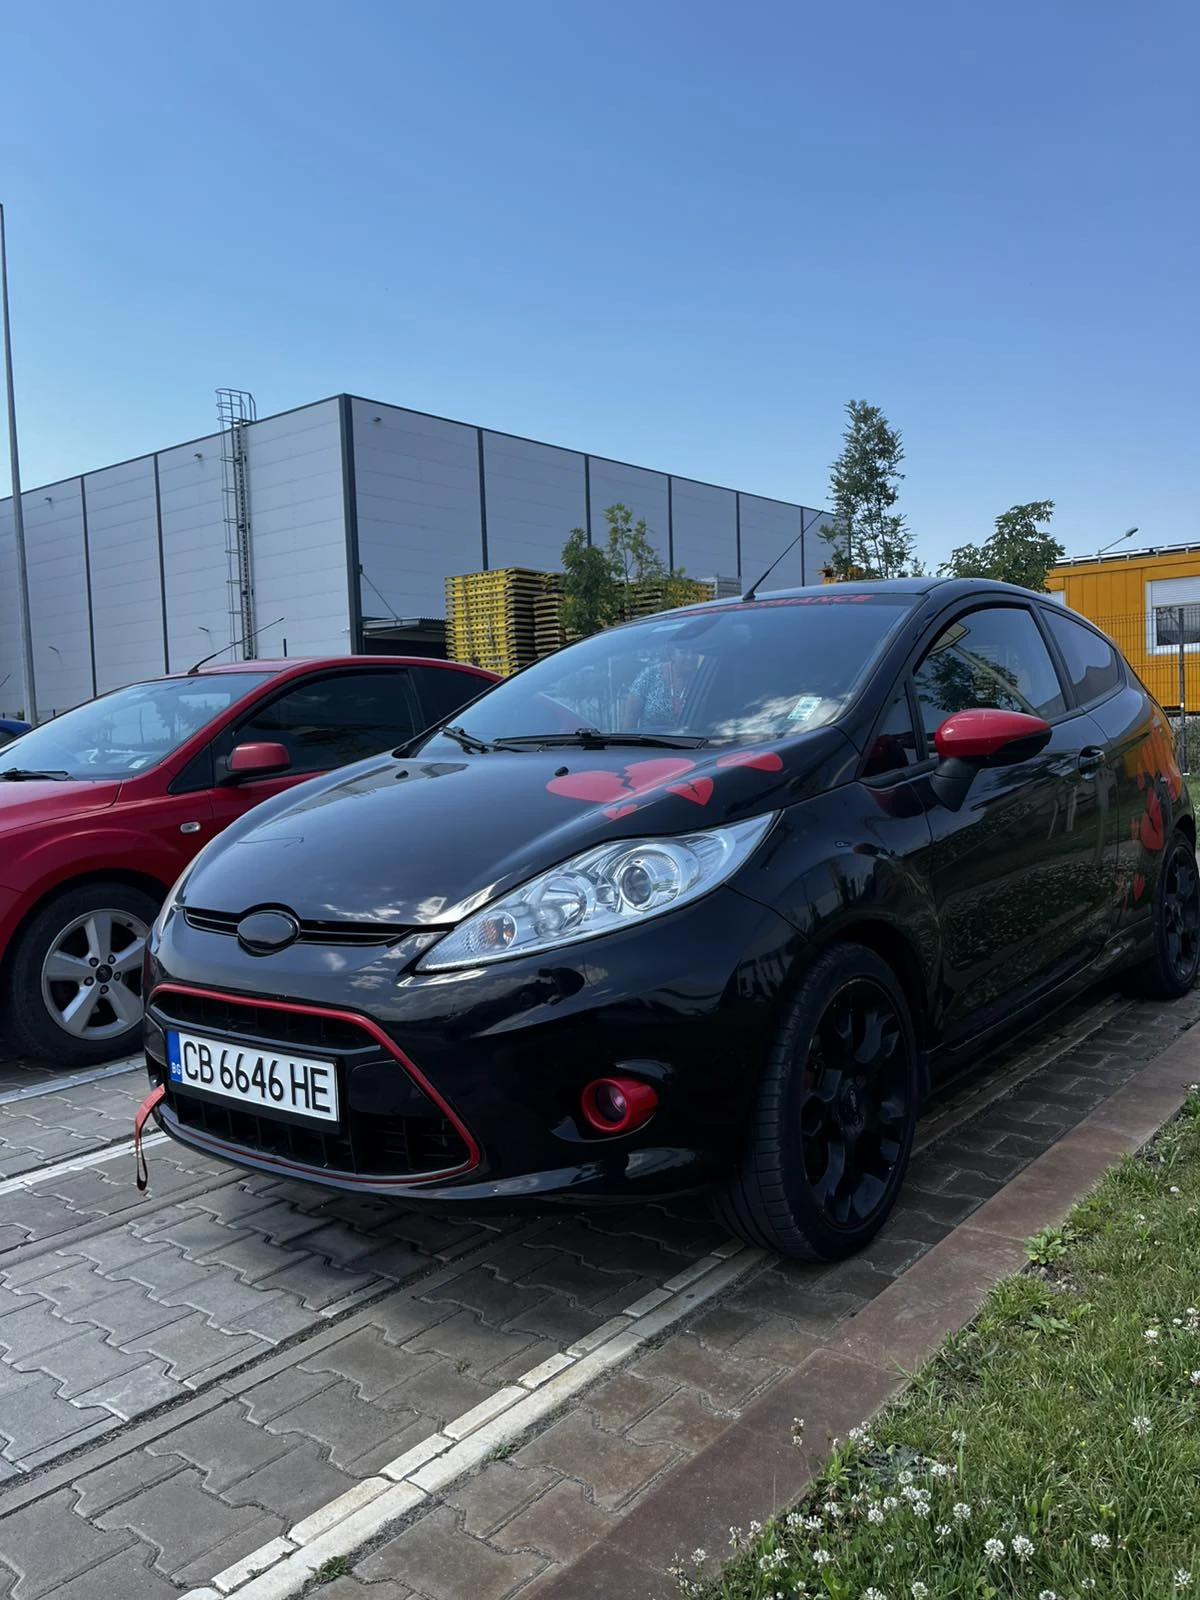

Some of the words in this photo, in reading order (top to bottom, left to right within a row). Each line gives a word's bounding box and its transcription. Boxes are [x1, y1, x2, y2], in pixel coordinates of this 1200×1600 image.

[171, 1062, 182, 1075] BG
[183, 1041, 214, 1084] CB
[220, 1050, 284, 1101] 6646
[289, 1063, 331, 1113] HE
